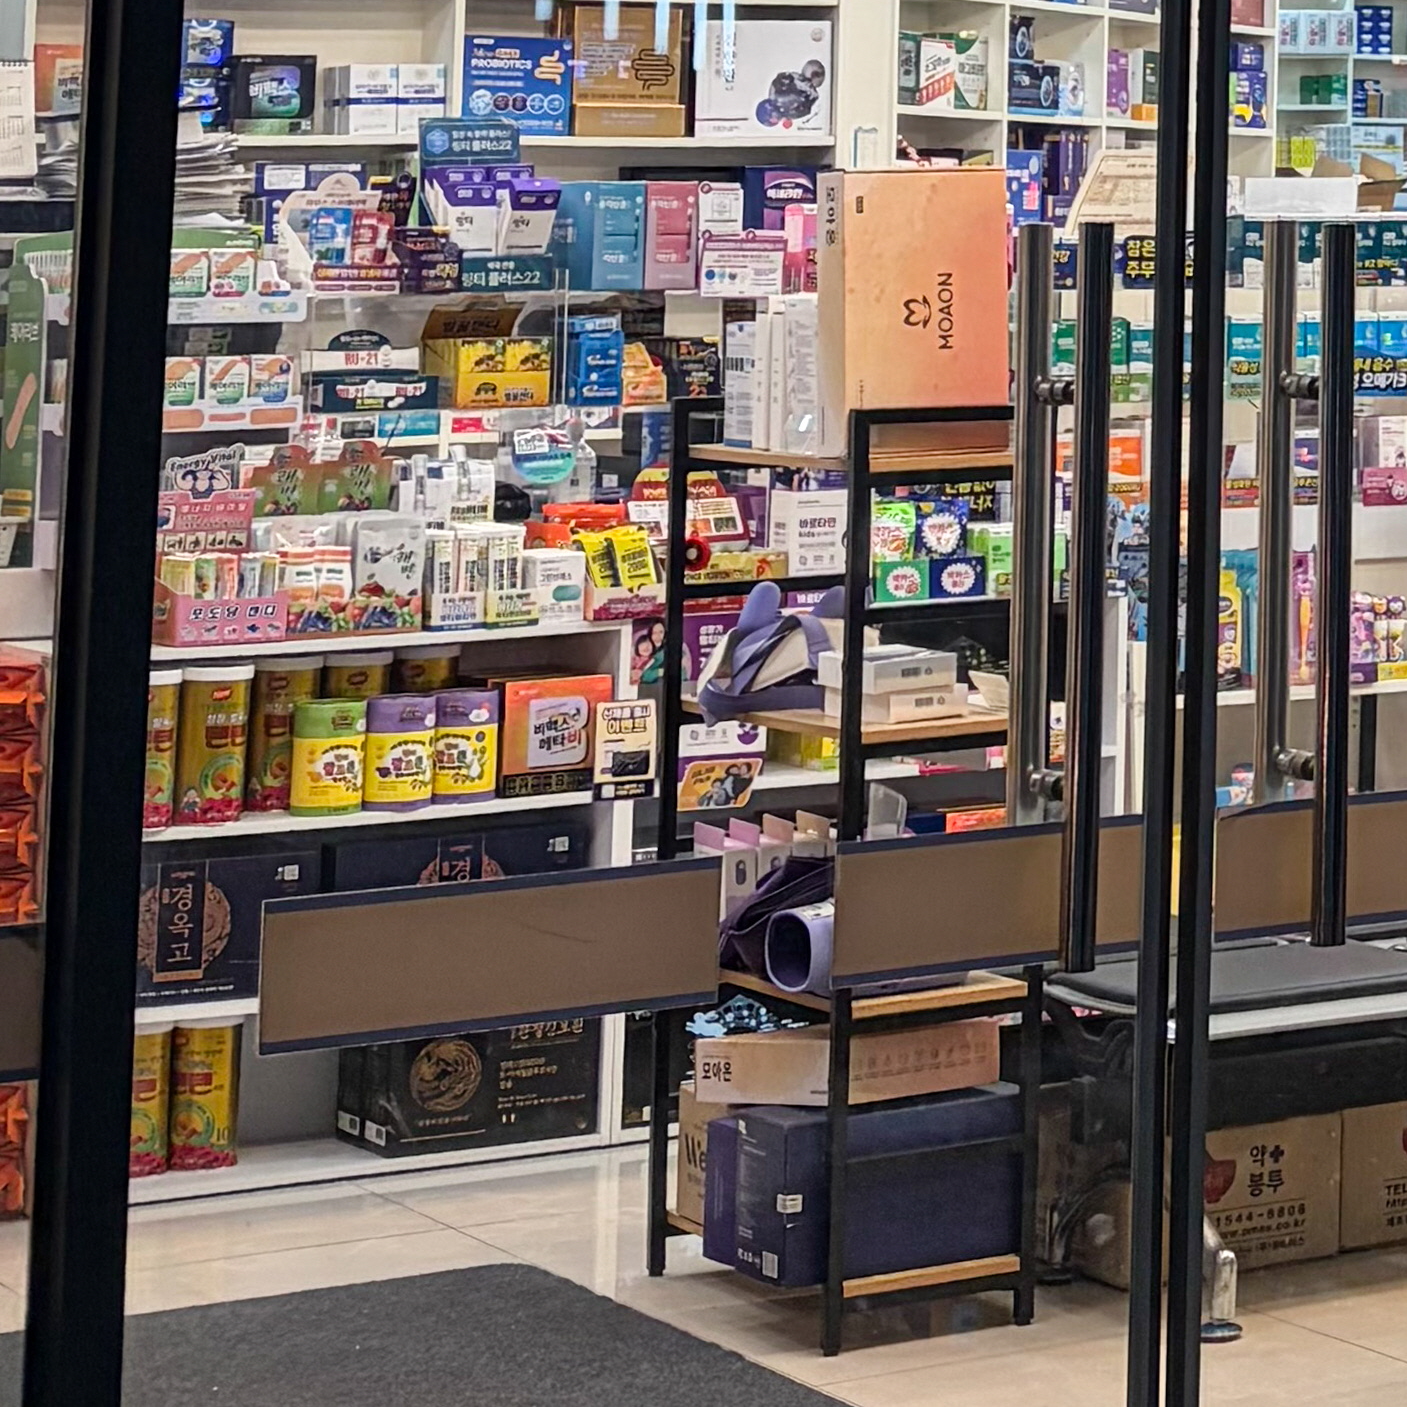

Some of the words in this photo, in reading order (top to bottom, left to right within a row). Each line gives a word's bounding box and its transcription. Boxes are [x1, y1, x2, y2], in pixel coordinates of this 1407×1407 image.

[937, 272, 954, 351] MOAON
[169, 456, 209, 474] Energy
[210, 451, 238, 466] Vital
[533, 718, 574, 736] 비맥스
[606, 718, 648, 735] 이벤트
[166, 884, 195, 964] 경옥고
[701, 1059, 733, 1083] 모아온
[1247, 1169, 1286, 1198] 봉투
